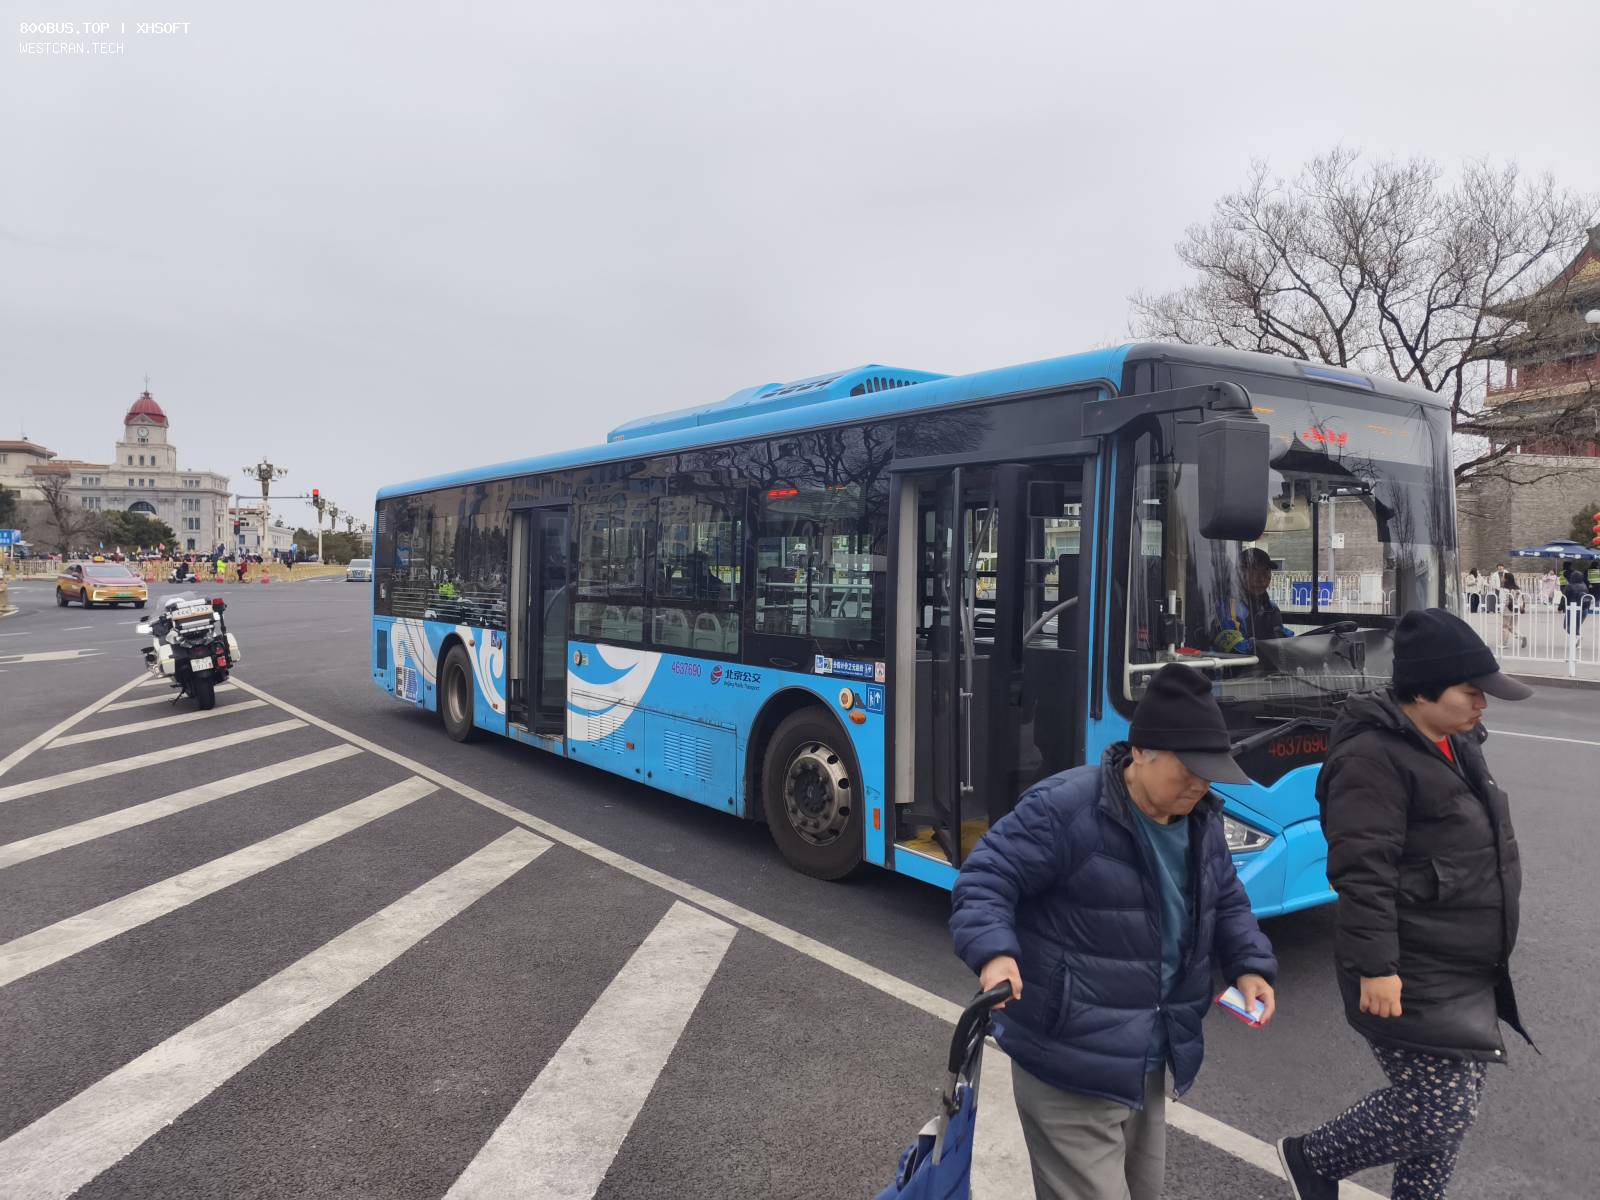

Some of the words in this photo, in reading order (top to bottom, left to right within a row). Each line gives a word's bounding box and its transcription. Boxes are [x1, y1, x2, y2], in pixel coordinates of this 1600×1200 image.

[724, 669, 761, 684] 北京公交
[1268, 733, 1329, 757] 4637690
